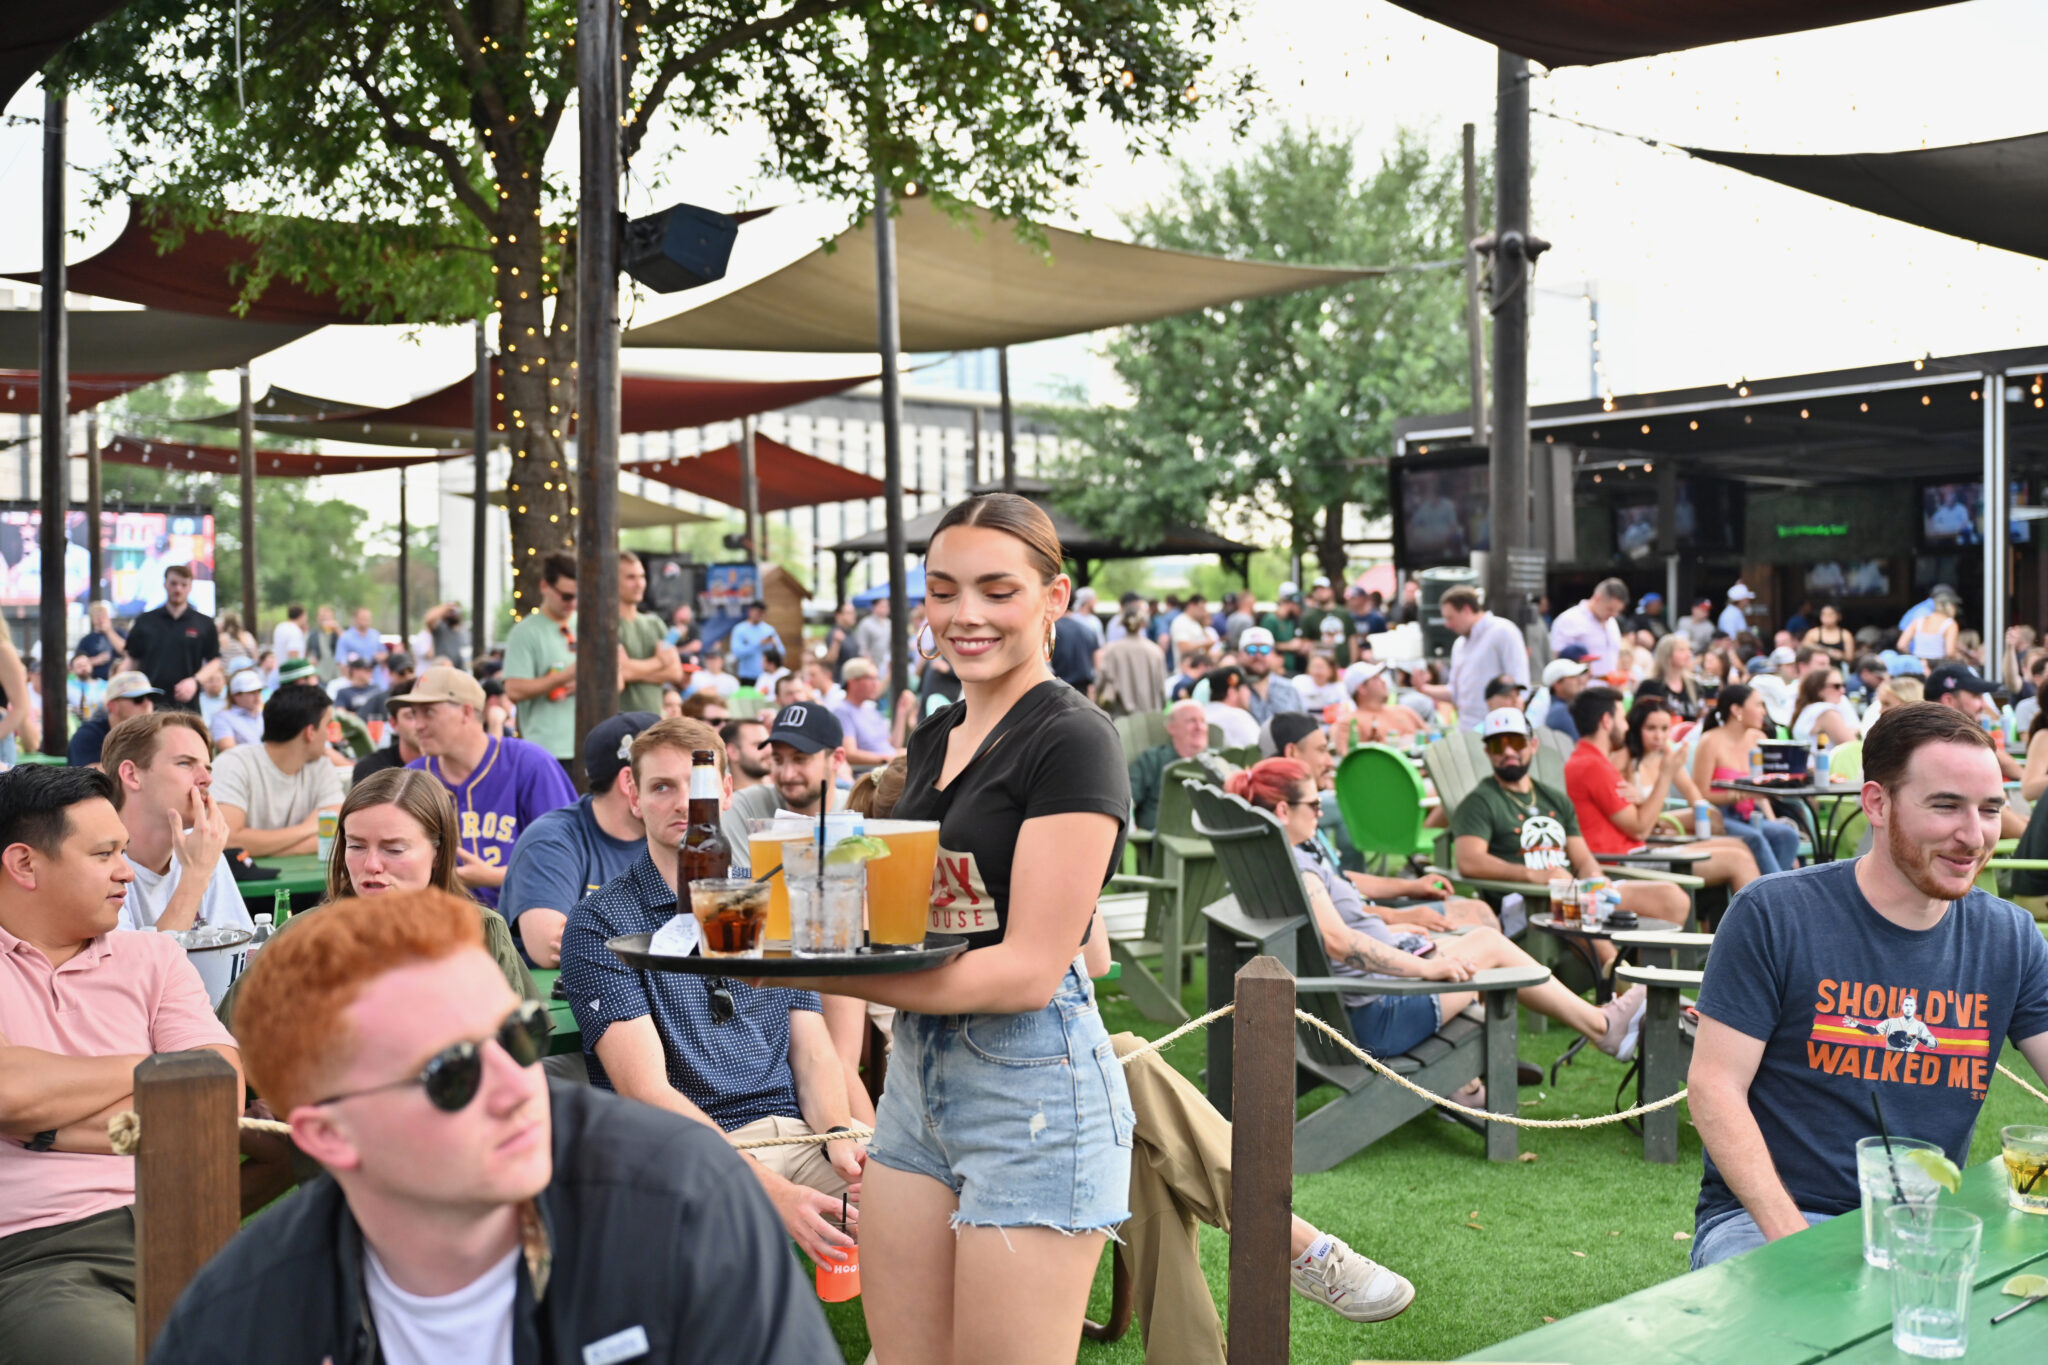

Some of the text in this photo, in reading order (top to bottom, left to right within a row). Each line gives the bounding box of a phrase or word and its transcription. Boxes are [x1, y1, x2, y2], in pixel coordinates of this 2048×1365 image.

[1814, 978, 1989, 1028] SHOULD'VE
[1807, 1040, 1988, 1090] WALKED ME
[834, 1264, 859, 1274] HOO
